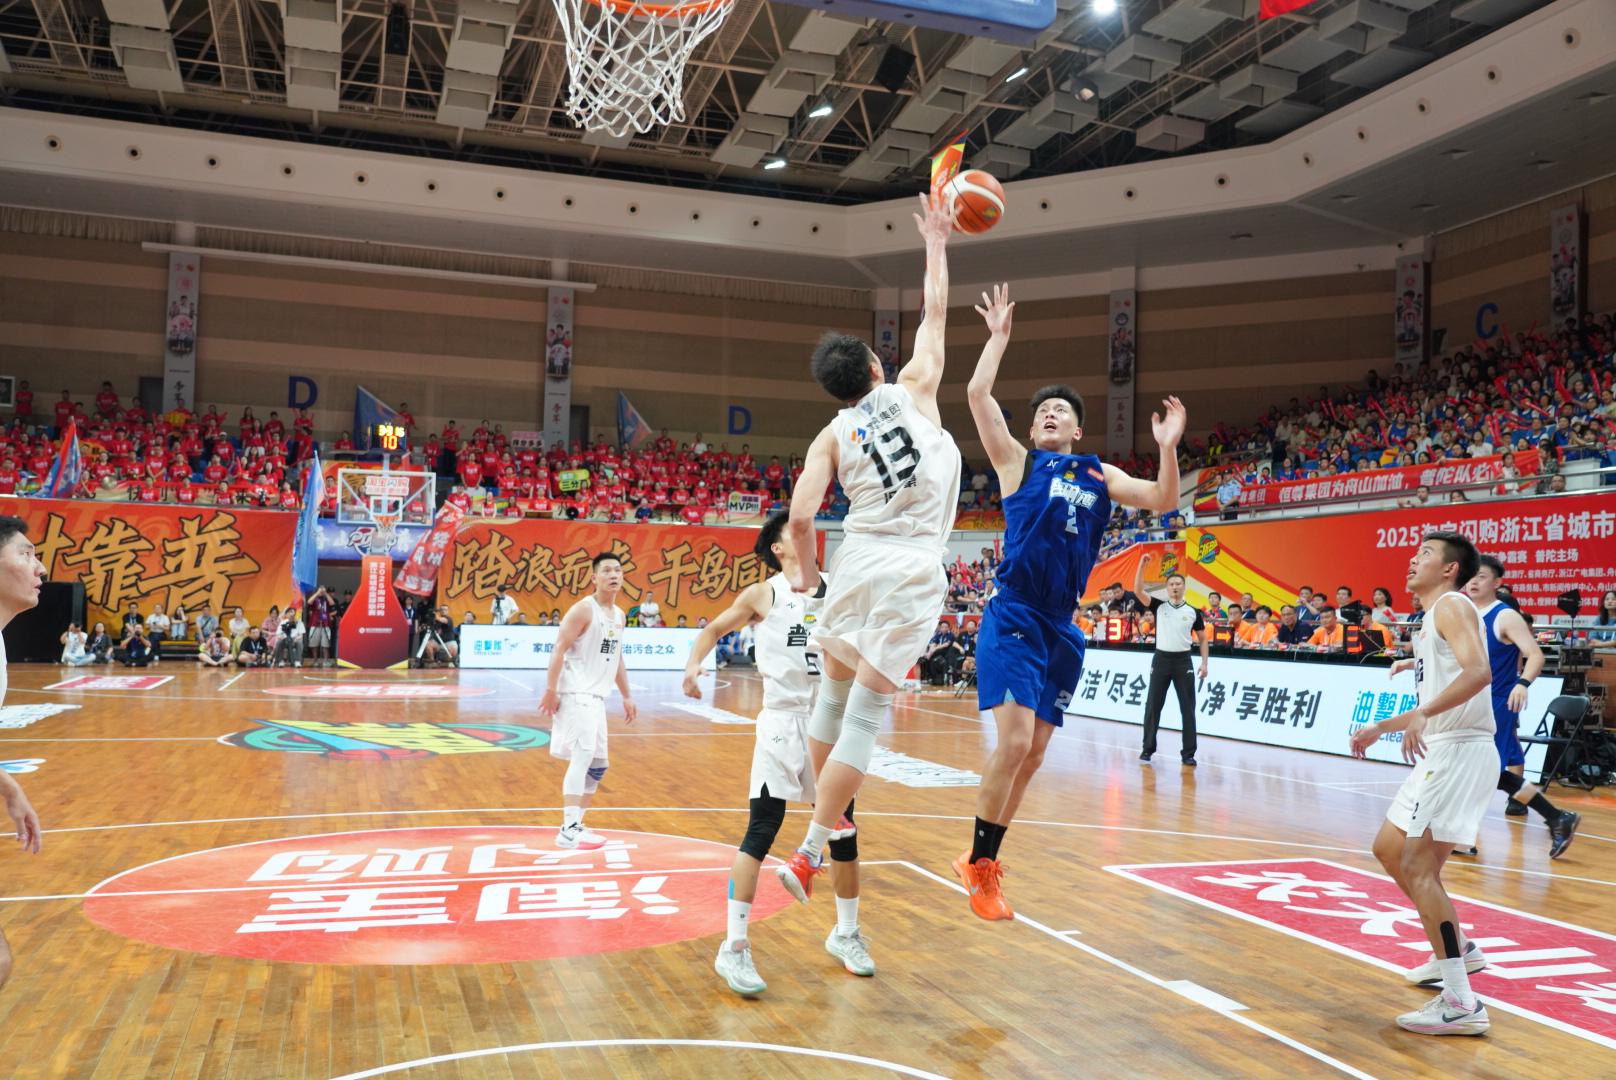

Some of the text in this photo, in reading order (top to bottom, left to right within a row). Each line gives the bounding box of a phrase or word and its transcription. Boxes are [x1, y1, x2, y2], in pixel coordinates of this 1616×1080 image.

[1475, 303, 1499, 339] C
[287, 375, 318, 409] D
[728, 405, 752, 435] D
[383, 435, 398, 450] 10
[862, 426, 922, 489] 13
[560, 480, 588, 490] 三分
[729, 501, 759, 512] MVP!!!
[1064, 504, 1079, 535] 2
[1535, 547, 1579, 564] 普陀主场
[649, 541, 779, 608] 千岛同
[787, 623, 811, 647] 普
[1108, 618, 1122, 641] 3
[804, 652, 821, 676] 5
[235, 875, 680, 935] 淘宝
